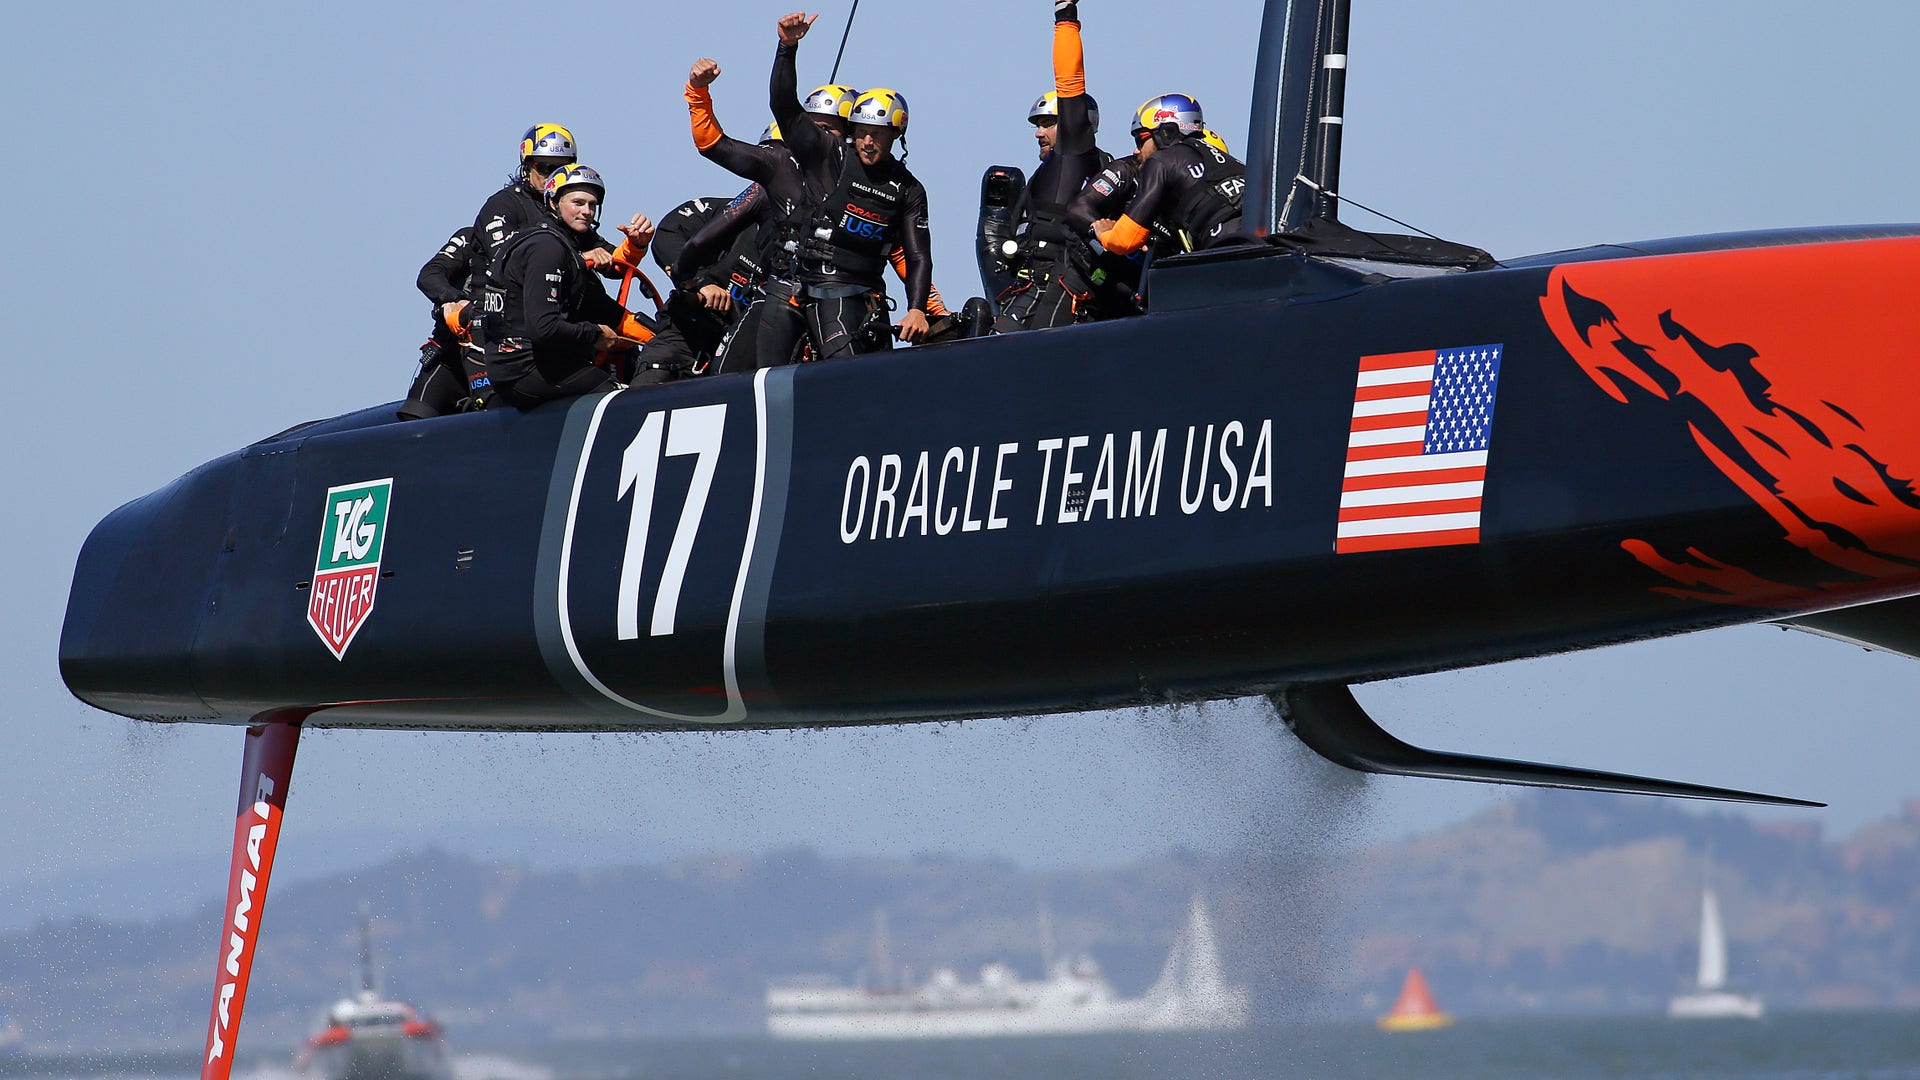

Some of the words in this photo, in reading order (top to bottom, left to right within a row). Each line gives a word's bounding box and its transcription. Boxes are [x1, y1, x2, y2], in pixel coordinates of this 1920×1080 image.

[861, 112, 877, 120] USA
[851, 181, 871, 193] ORACLE
[872, 188, 886, 198] TEAM
[886, 194, 896, 202] USA
[838, 214, 849, 228] TEAM
[846, 217, 884, 241] USA
[739, 254, 756, 269] ORACLE
[471, 377, 492, 389] USA
[840, 442, 1019, 545] ORACLE
[1036, 428, 1168, 526] TEAM
[1179, 419, 1272, 515] USA
[331, 490, 377, 563] TAG
[617, 403, 728, 641] 17
[313, 573, 373, 646] HEUER
[207, 772, 275, 1065] YANMAR
